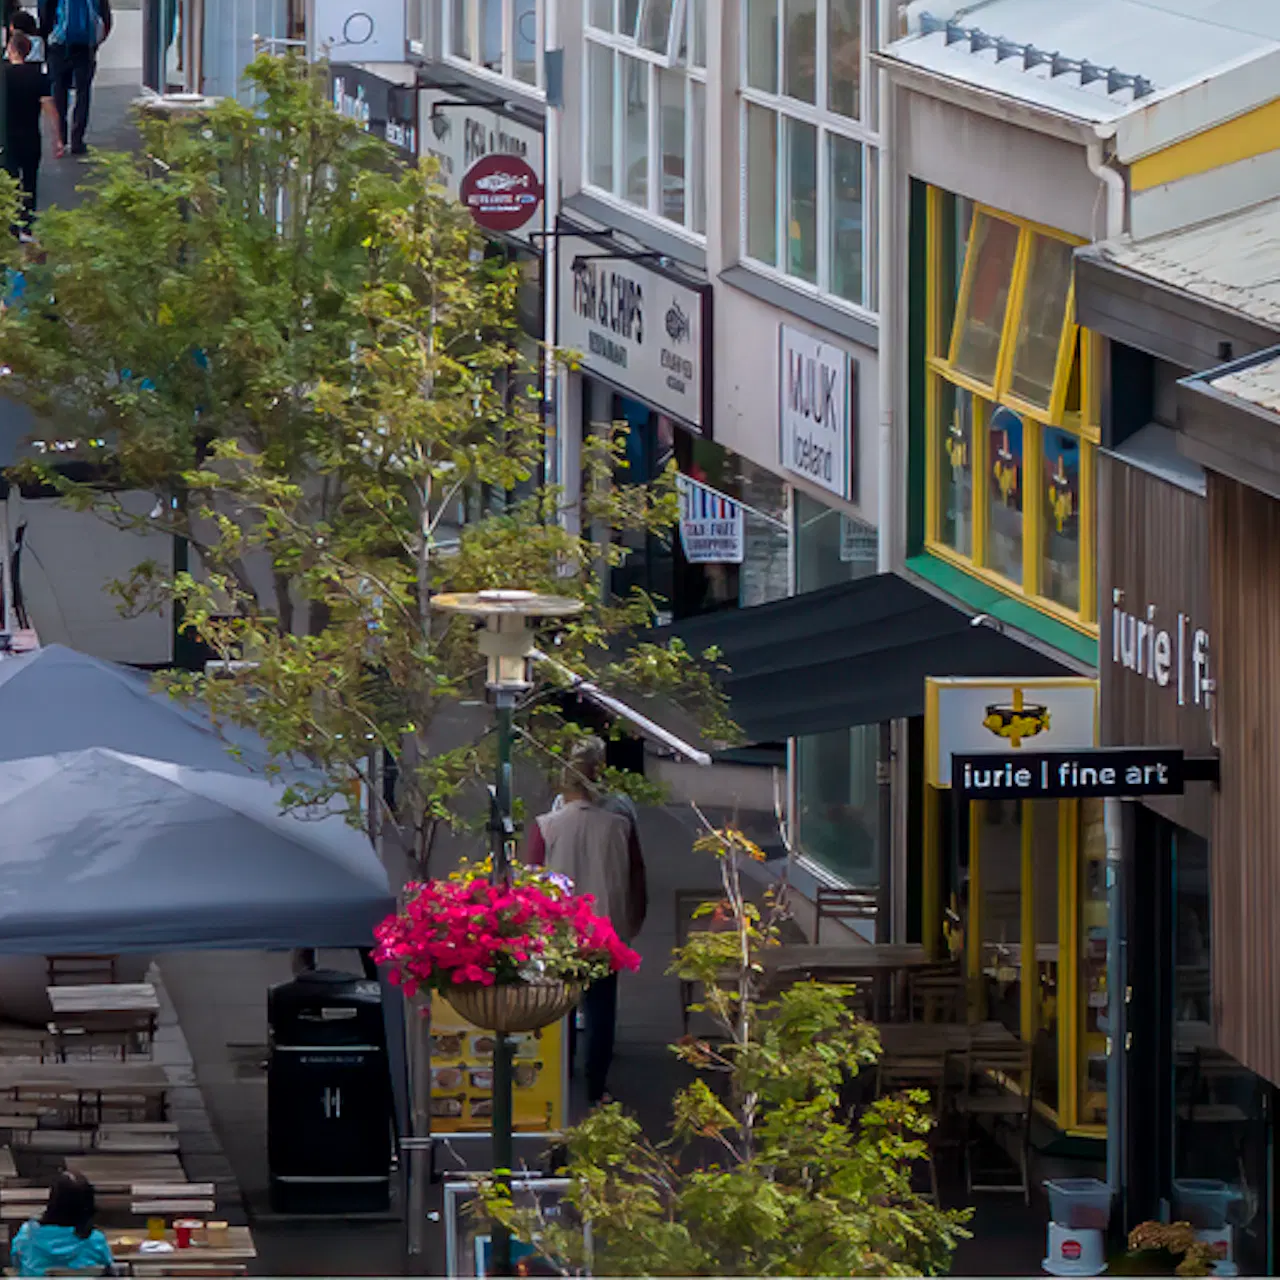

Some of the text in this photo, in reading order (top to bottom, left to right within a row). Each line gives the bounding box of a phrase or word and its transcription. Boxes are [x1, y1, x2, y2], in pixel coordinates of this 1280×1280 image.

[610, 272, 642, 344] CHIPS
[790, 344, 837, 432] MJÚK
[793, 423, 832, 483] Iceland
[1112, 587, 1171, 687] iurie
[963, 762, 1032, 789] iurie
[1058, 761, 1116, 787] fine
[1125, 762, 1169, 785] art
